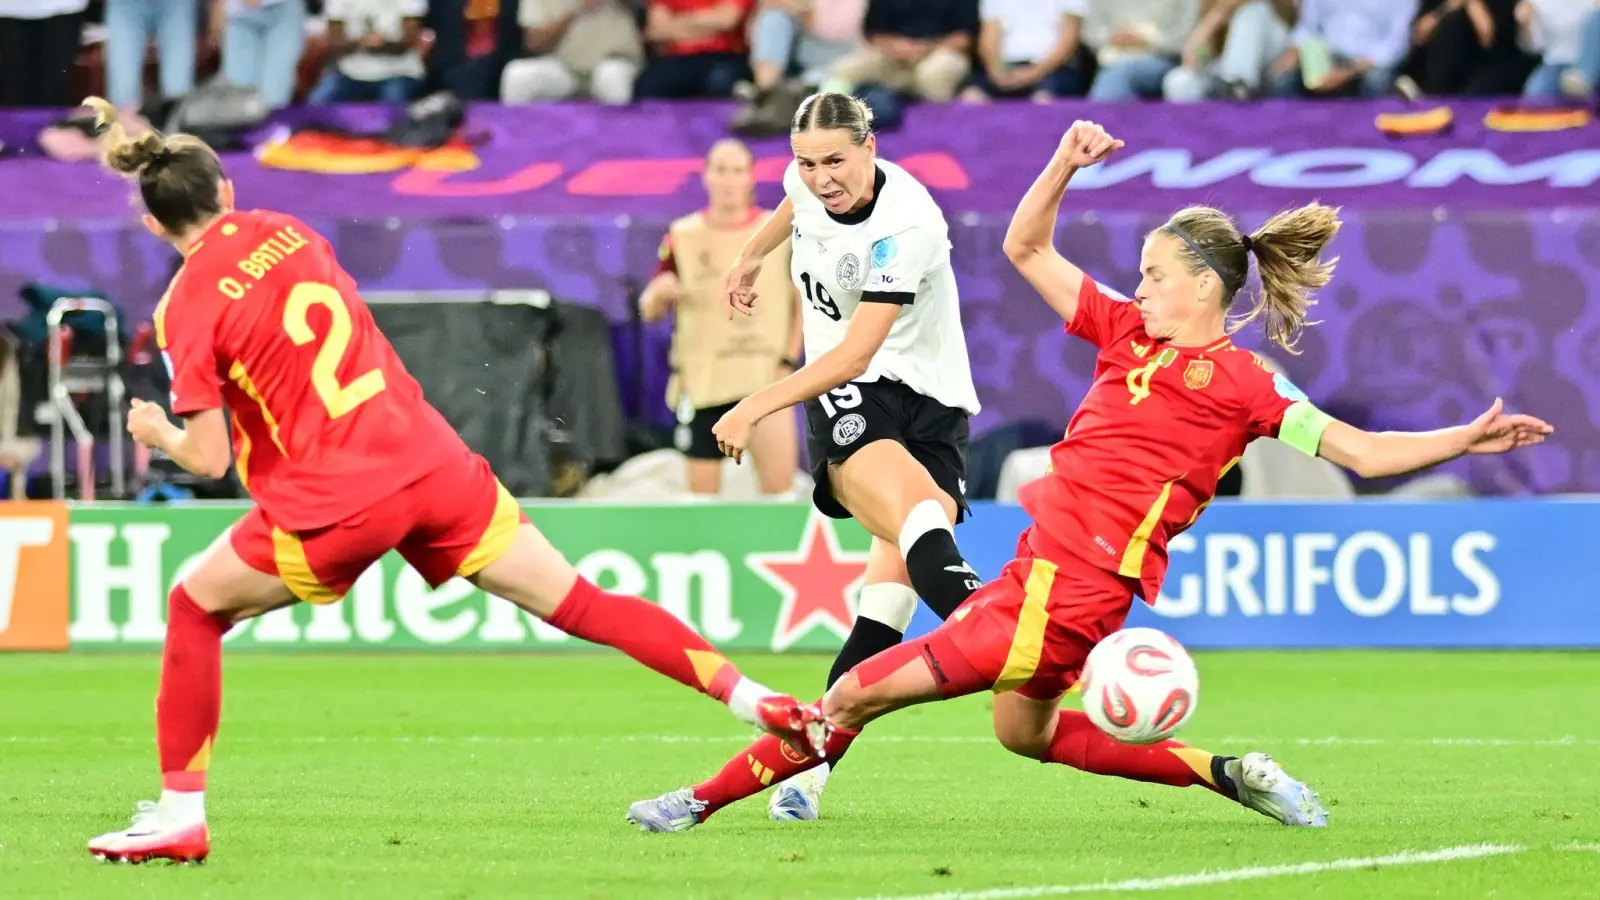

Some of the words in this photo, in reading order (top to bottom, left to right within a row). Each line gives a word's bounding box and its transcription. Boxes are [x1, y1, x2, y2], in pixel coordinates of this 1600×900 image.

[391, 157, 971, 197] UE
[218, 277, 252, 300] O.
[237, 226, 309, 280] BATLLE
[800, 271, 841, 321] 19
[282, 281, 386, 420] 2
[818, 383, 863, 419] 19
[1126, 362, 1160, 405] 4
[68, 523, 742, 643] Hneen
[1147, 530, 1500, 618] GRIFOLS
